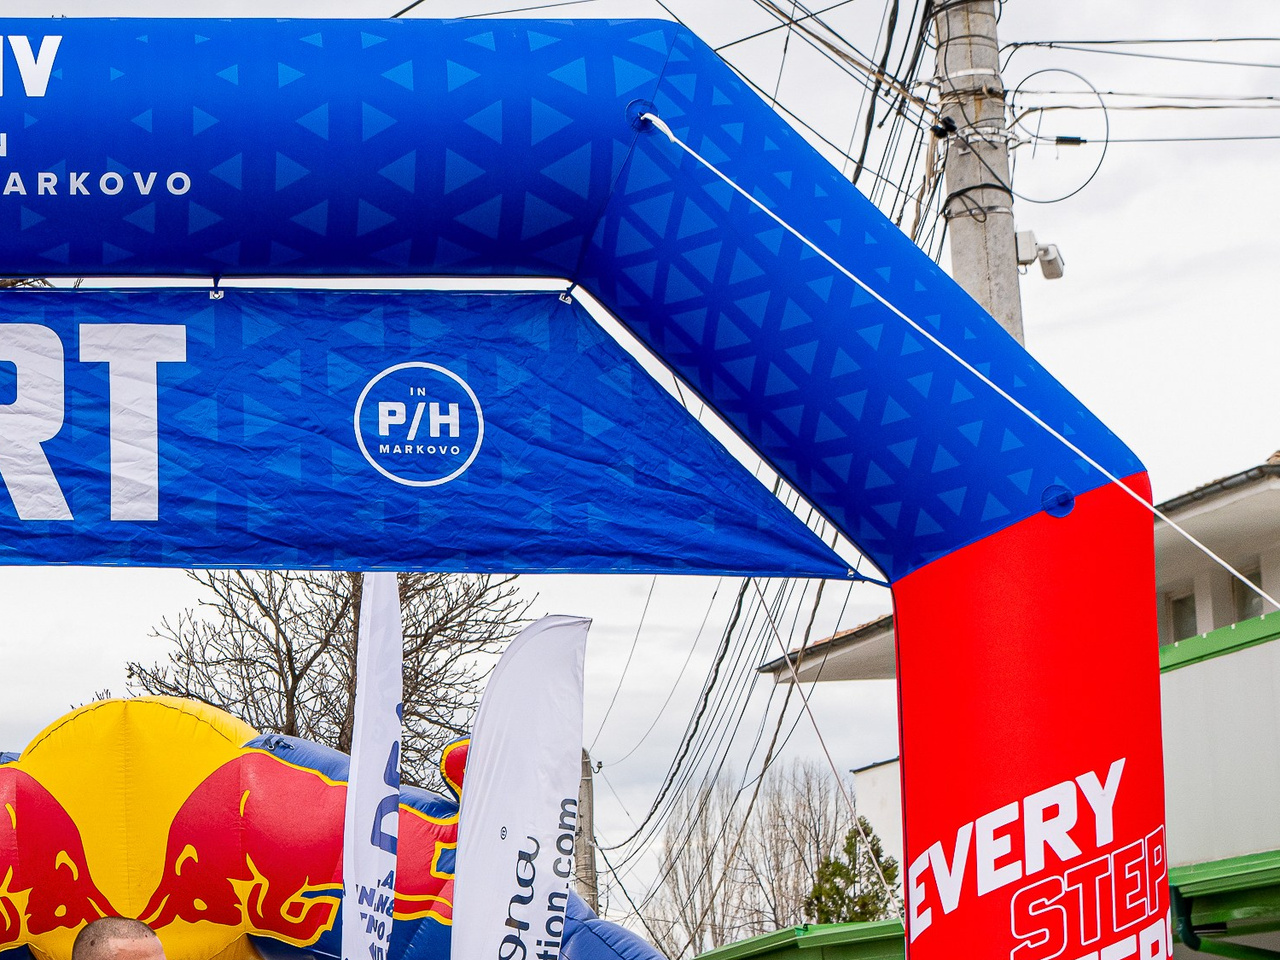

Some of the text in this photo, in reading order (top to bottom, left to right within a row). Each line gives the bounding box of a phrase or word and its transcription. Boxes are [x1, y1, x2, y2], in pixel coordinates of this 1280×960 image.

[409, 386, 426, 397] IN
[378, 402, 460, 441] P/H
[379, 444, 460, 455] MARKOVO
[909, 757, 1126, 944] EVERY
